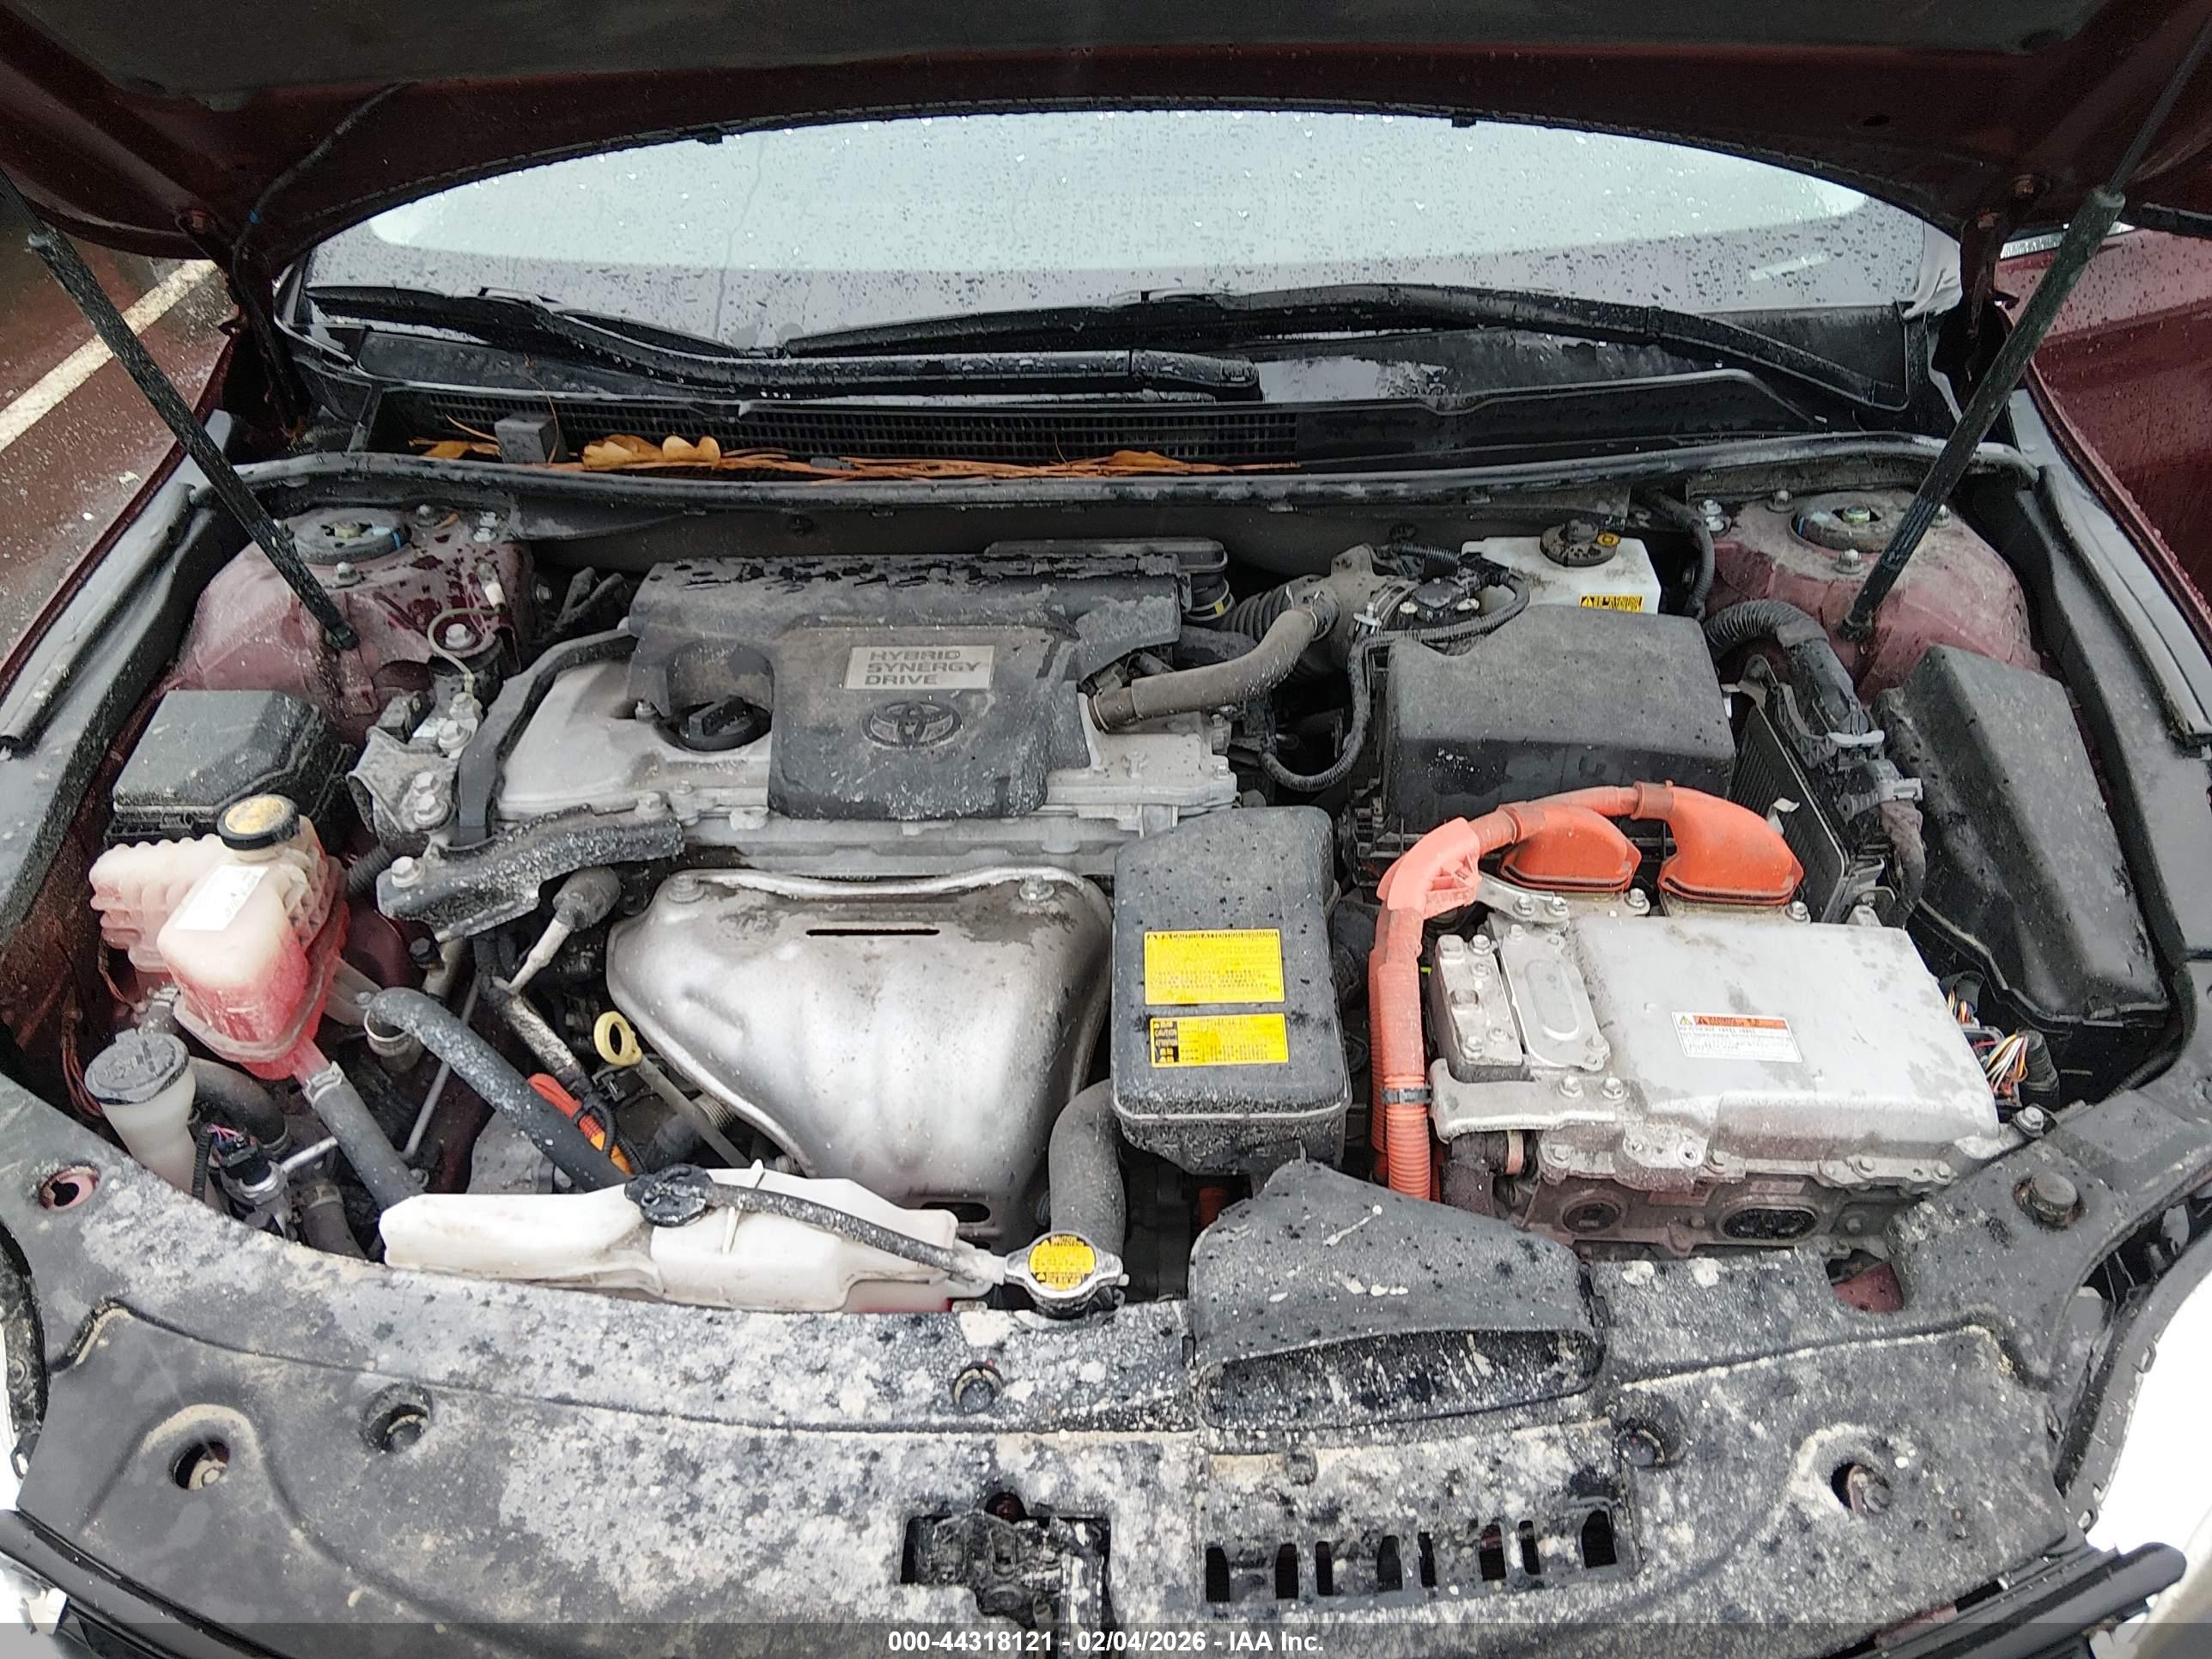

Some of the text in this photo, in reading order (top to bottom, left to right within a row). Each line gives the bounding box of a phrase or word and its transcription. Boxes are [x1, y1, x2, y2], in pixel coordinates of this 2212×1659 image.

[870, 650, 960, 661] HYBRID
[867, 662, 981, 673] SYNERGY
[865, 675, 938, 685] DRIVE
